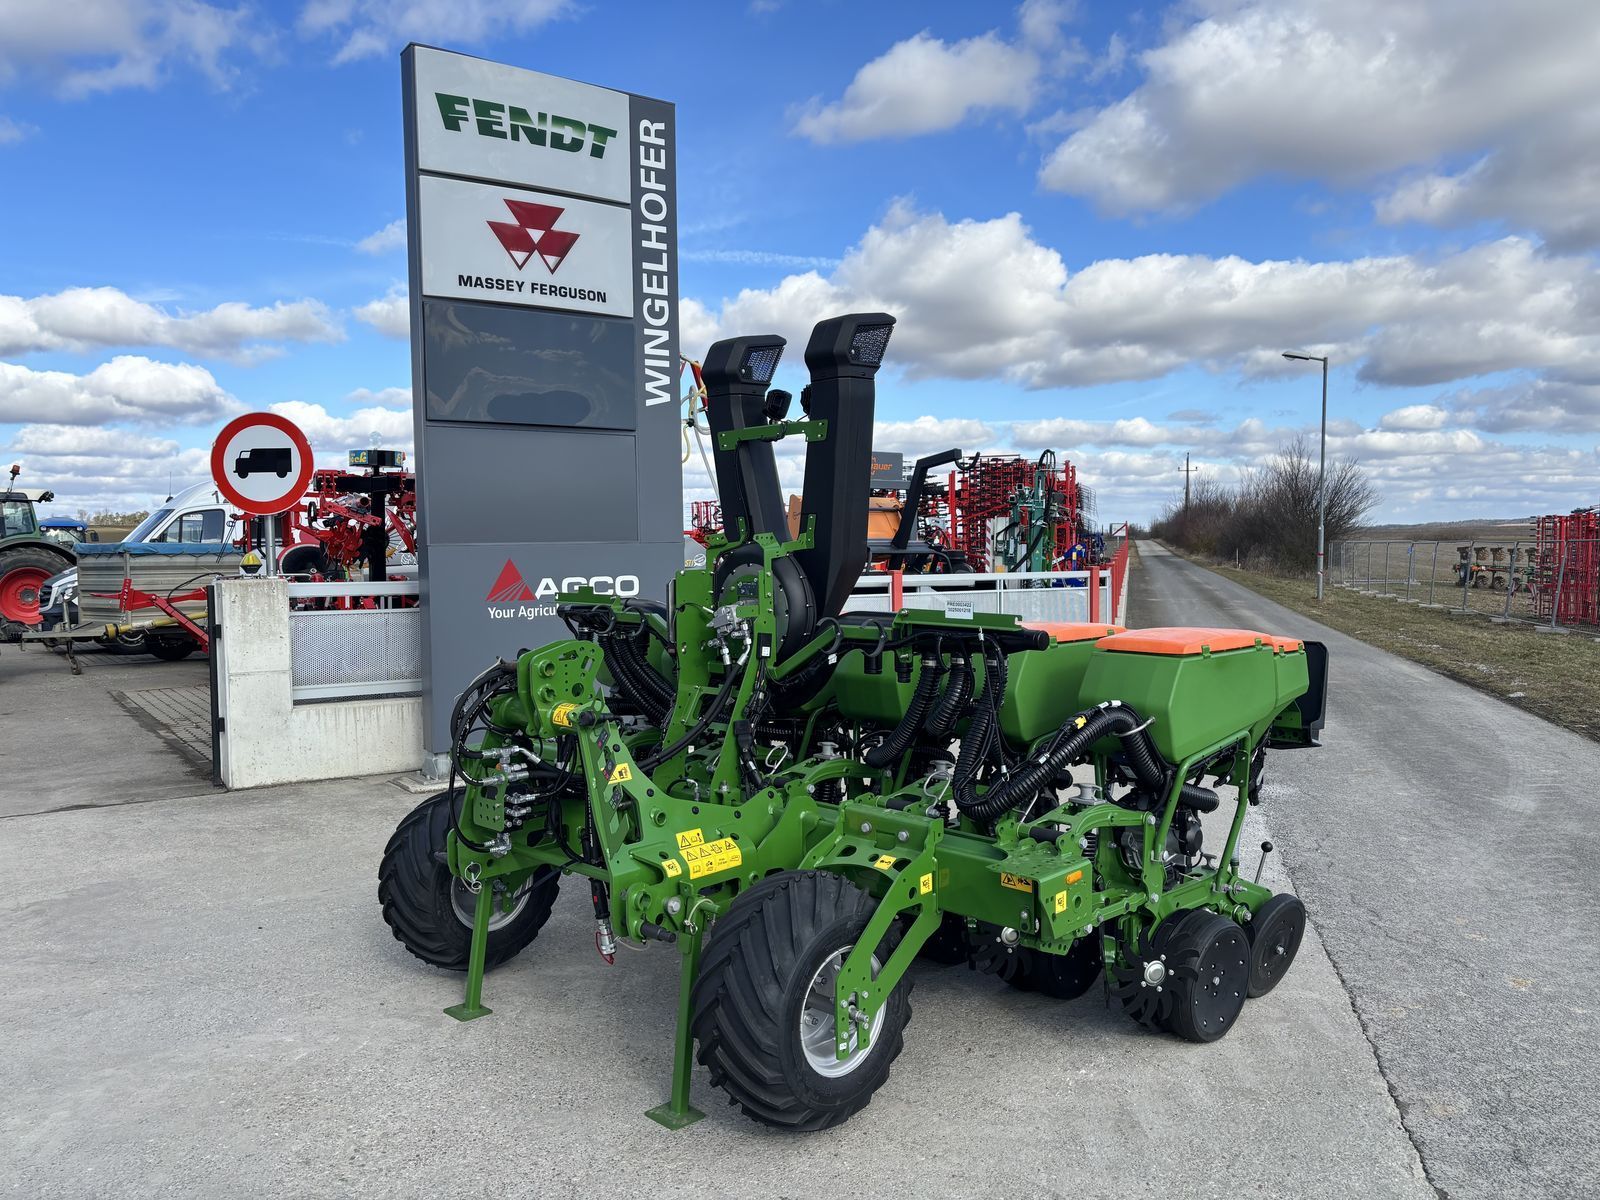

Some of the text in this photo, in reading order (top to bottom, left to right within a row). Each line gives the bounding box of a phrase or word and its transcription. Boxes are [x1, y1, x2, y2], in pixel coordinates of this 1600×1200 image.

[435, 92, 618, 159] FENDT
[639, 118, 671, 407] WINGELHOFER
[458, 274, 607, 303] MASSEY FERGUSON
[534, 574, 640, 601] AGCO
[487, 606, 516, 619] Your
